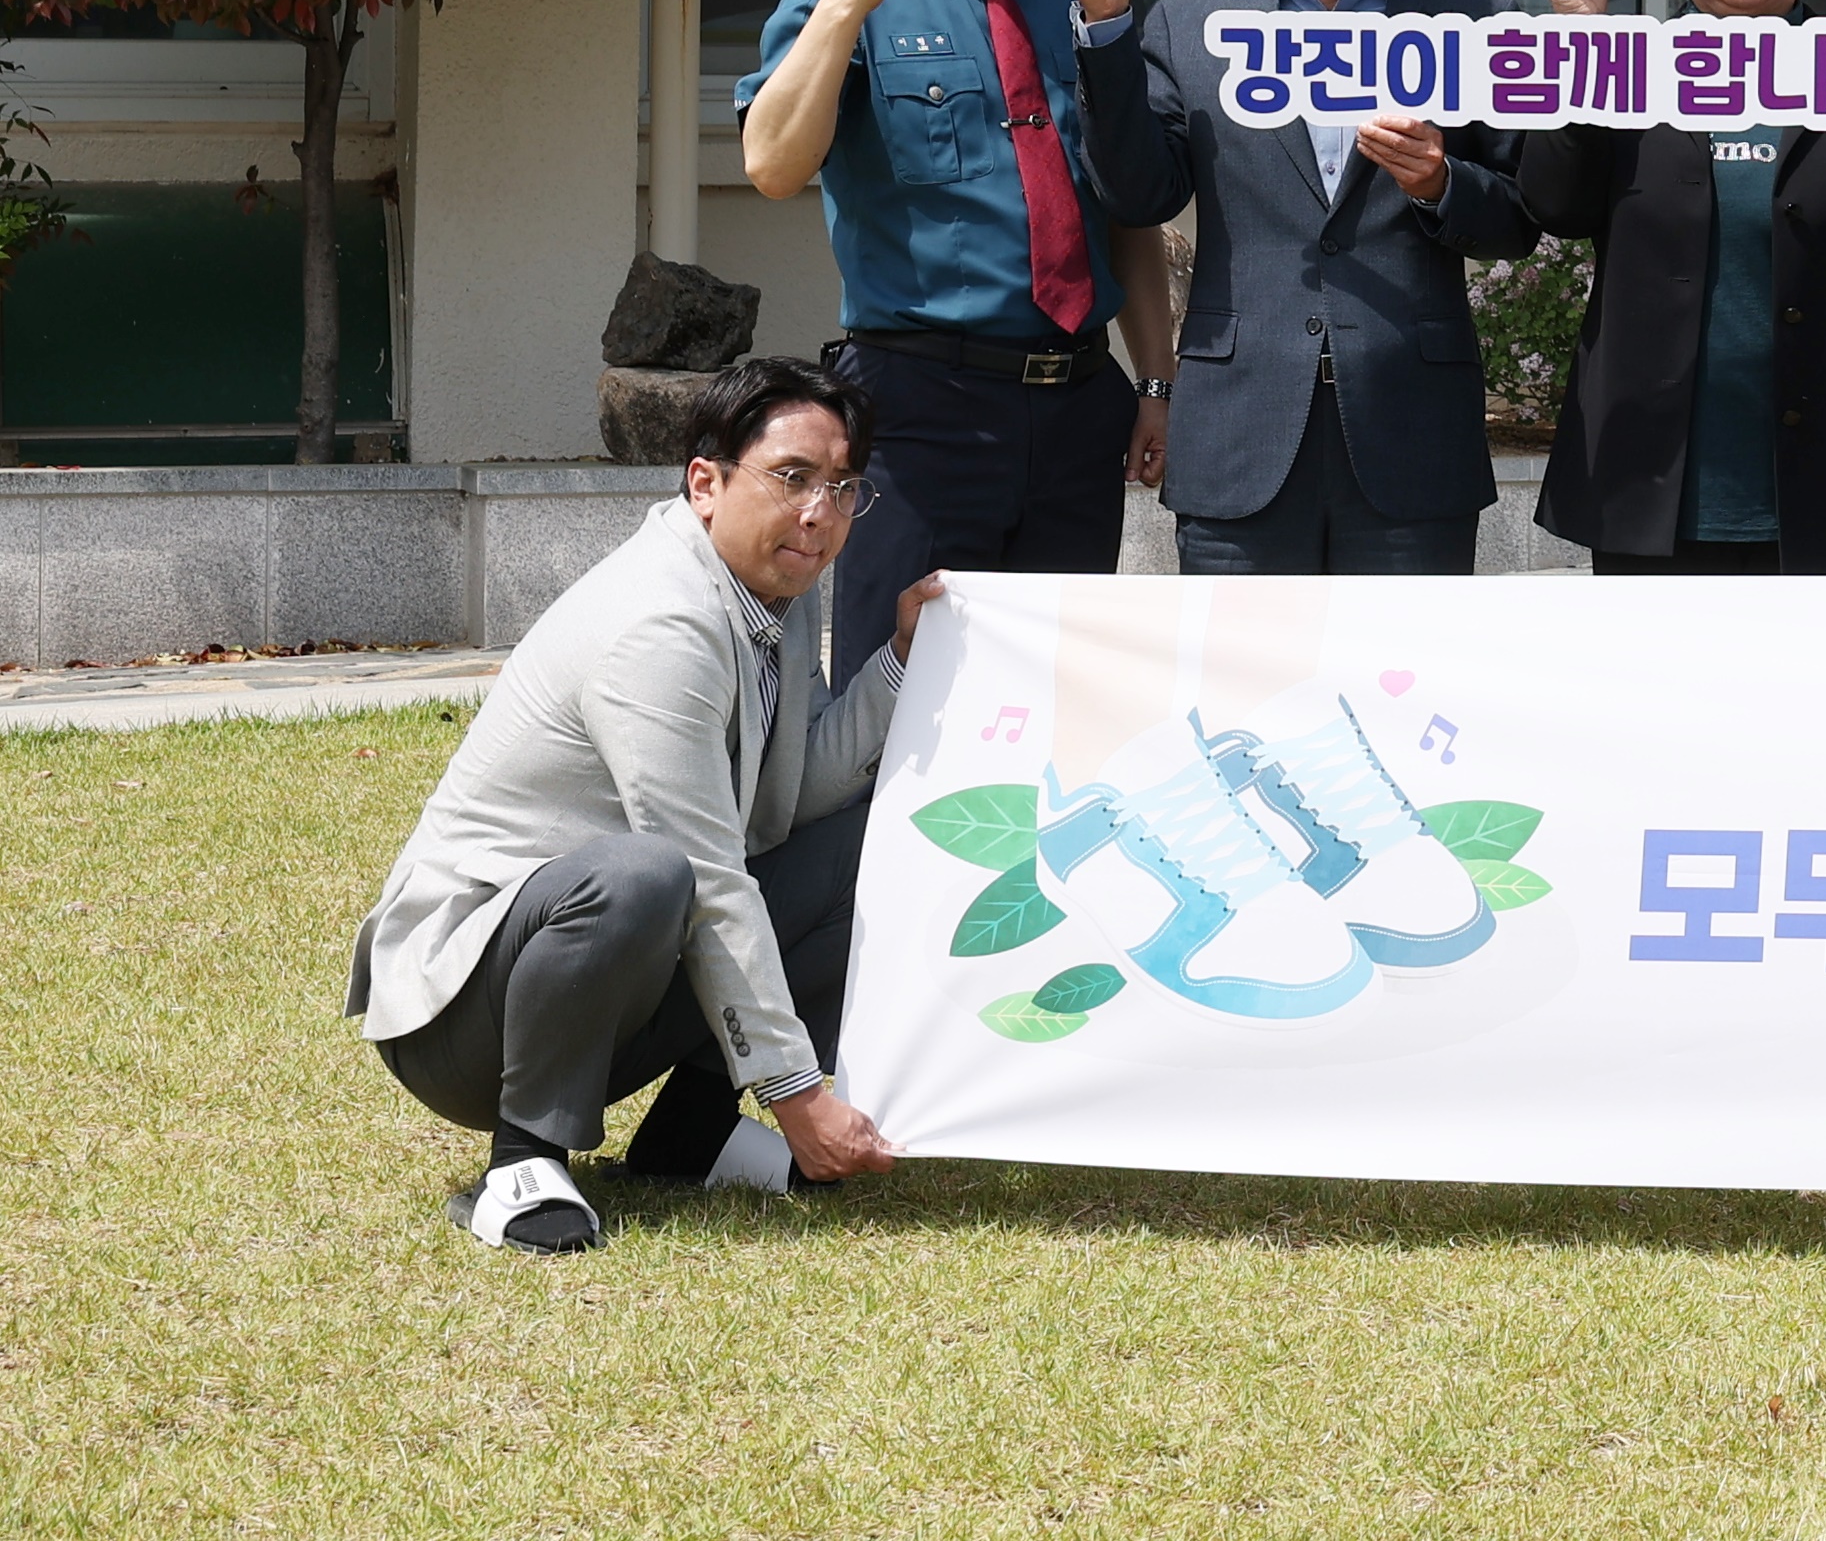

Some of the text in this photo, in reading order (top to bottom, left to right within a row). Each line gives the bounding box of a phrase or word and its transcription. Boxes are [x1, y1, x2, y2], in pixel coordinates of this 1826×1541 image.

[1220, 28, 1461, 114] 강진이
[1488, 28, 1646, 114] 함께
[1708, 133, 1777, 163] mo
[517, 1165, 540, 1194] PUMA
